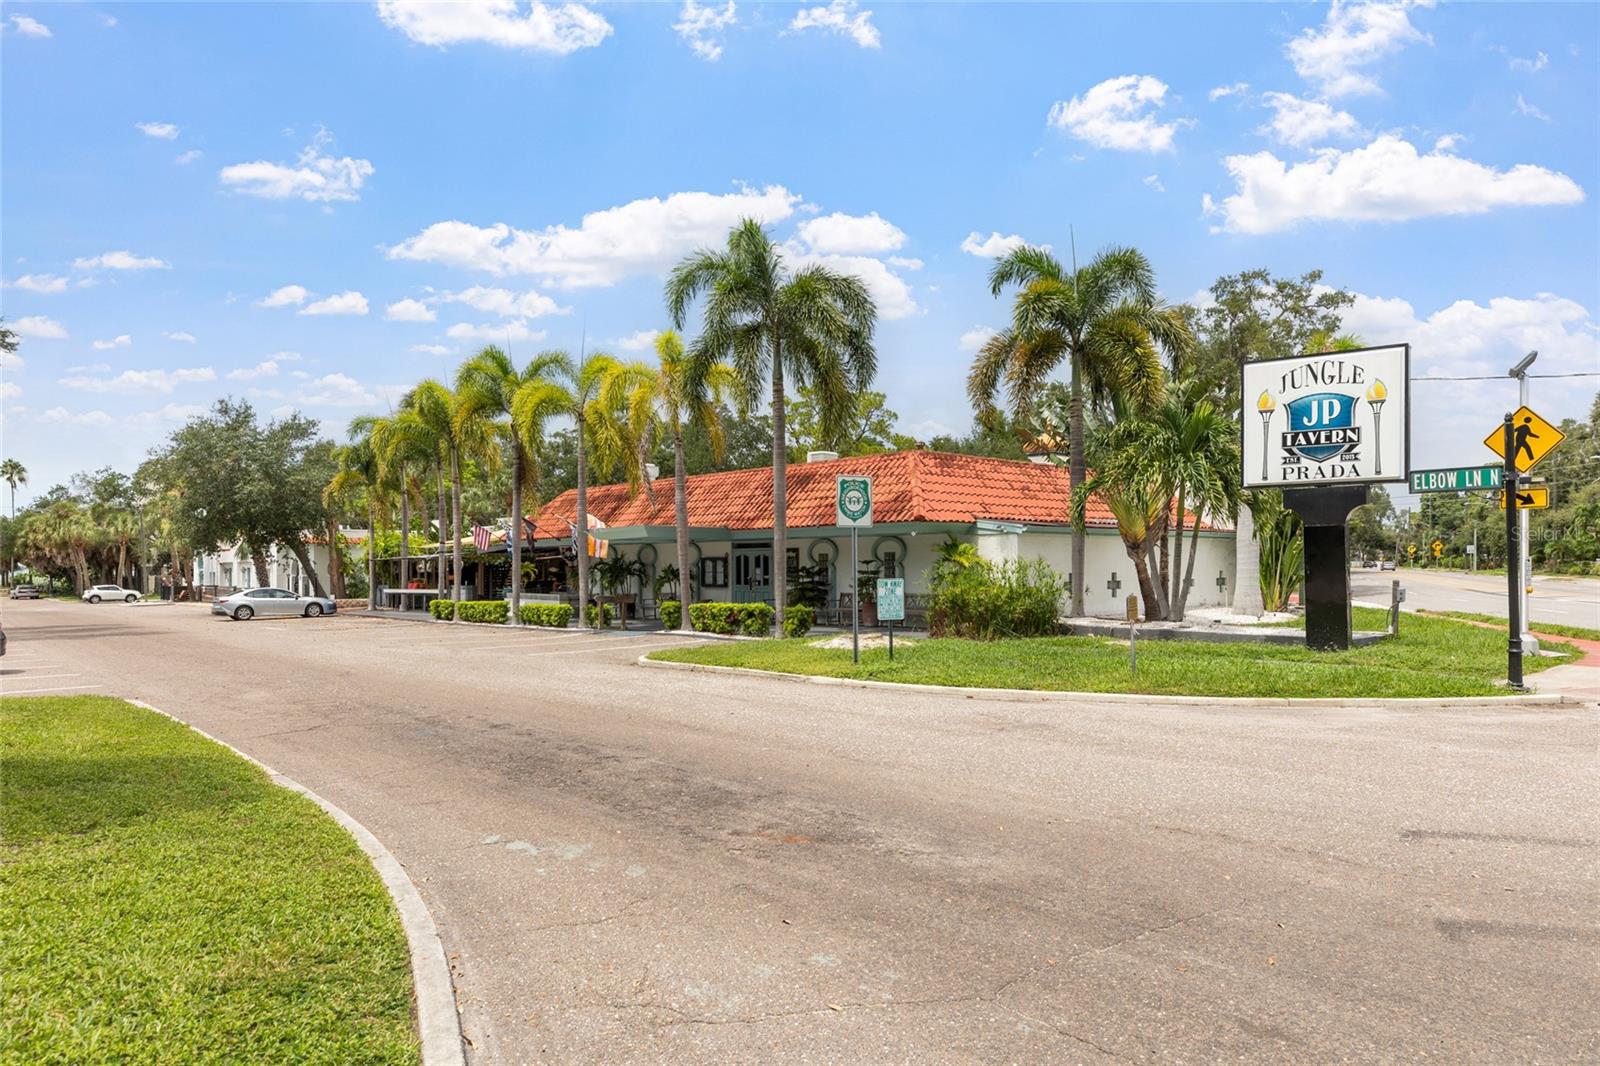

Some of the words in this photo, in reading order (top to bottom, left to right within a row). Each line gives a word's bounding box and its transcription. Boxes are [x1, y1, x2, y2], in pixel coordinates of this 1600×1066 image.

[1279, 359, 1365, 394] JUNGLE
[1303, 399, 1341, 426] JP
[1284, 429, 1359, 447] TAVERN
[1281, 463, 1361, 480] PRADA
[1414, 472, 1457, 490] ELBOW
[1466, 470, 1481, 487] LN
[1490, 468, 1499, 486] N
